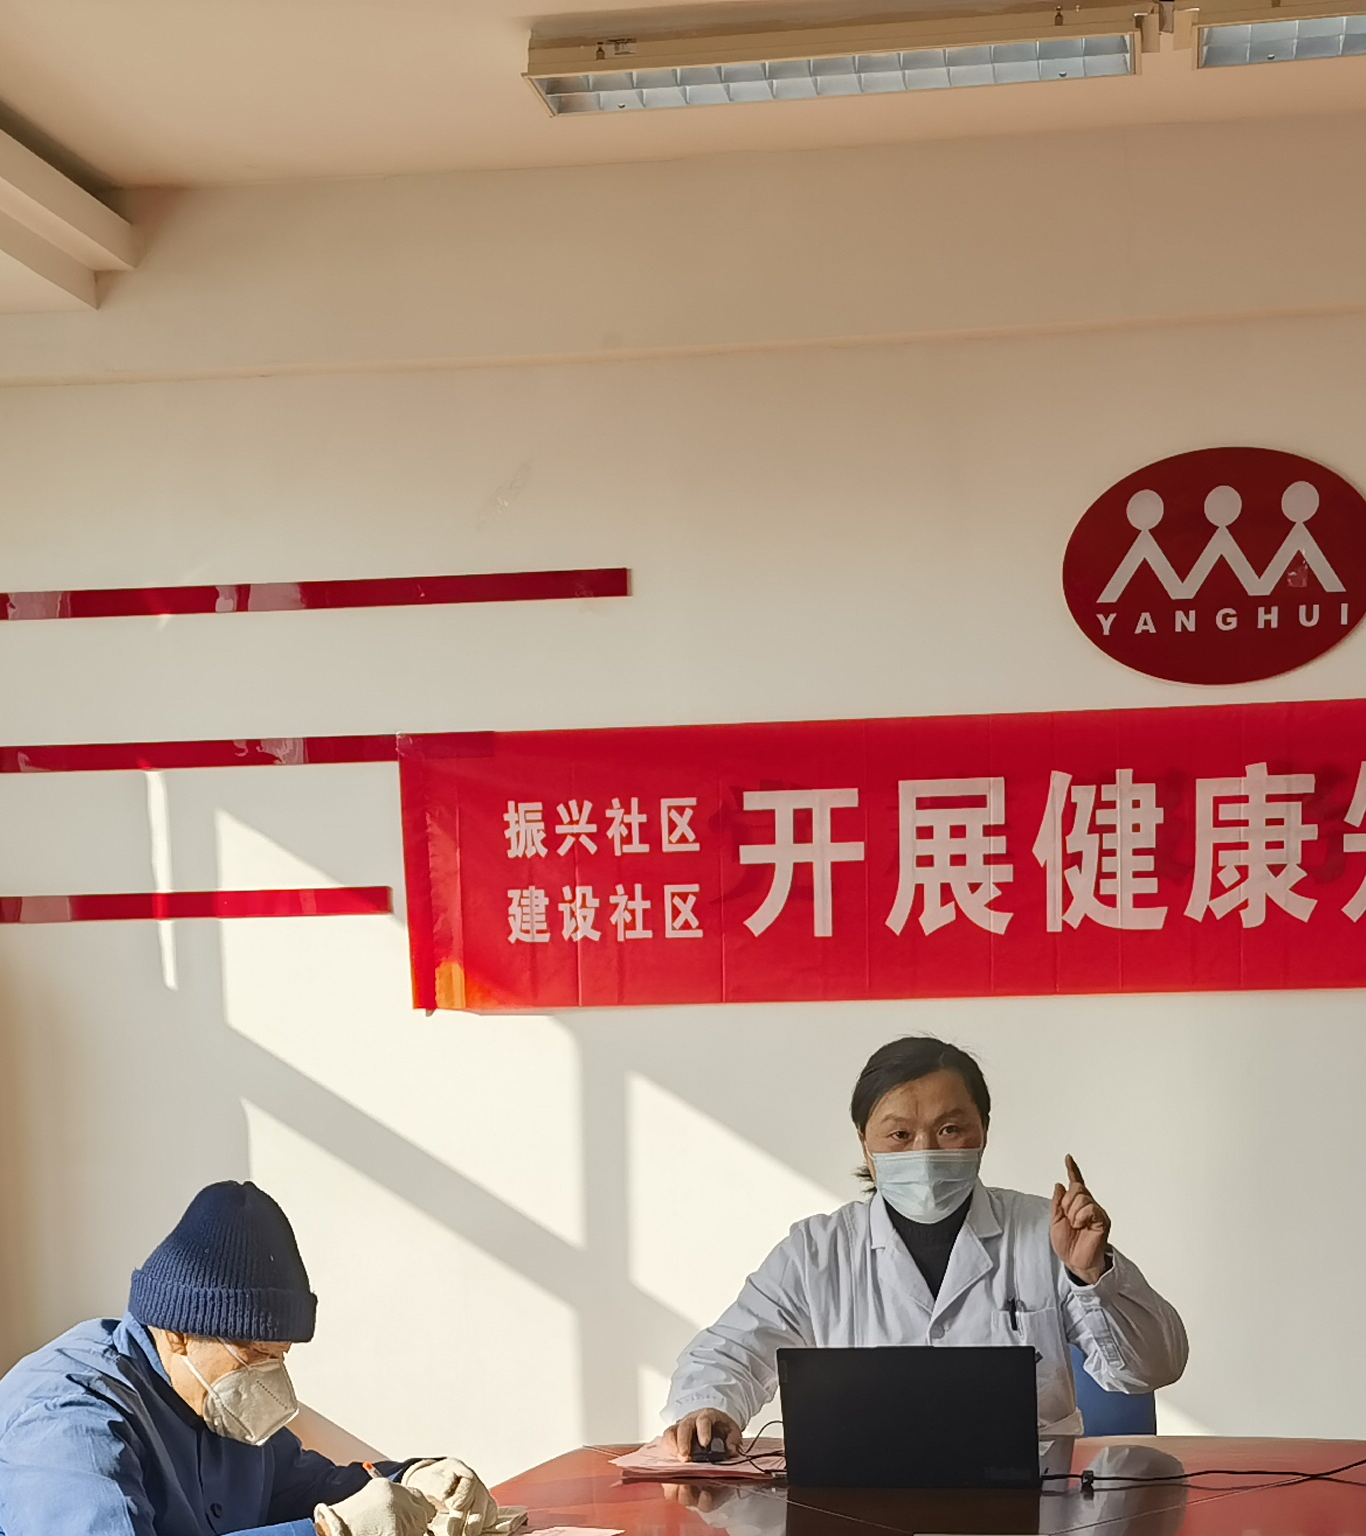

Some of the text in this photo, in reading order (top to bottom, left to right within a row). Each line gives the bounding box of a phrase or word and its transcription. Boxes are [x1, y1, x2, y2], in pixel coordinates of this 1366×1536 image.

[1096, 603, 1349, 636] YANGHUI
[503, 797, 700, 859] 振兴社区
[507, 883, 703, 944] 建设社区
